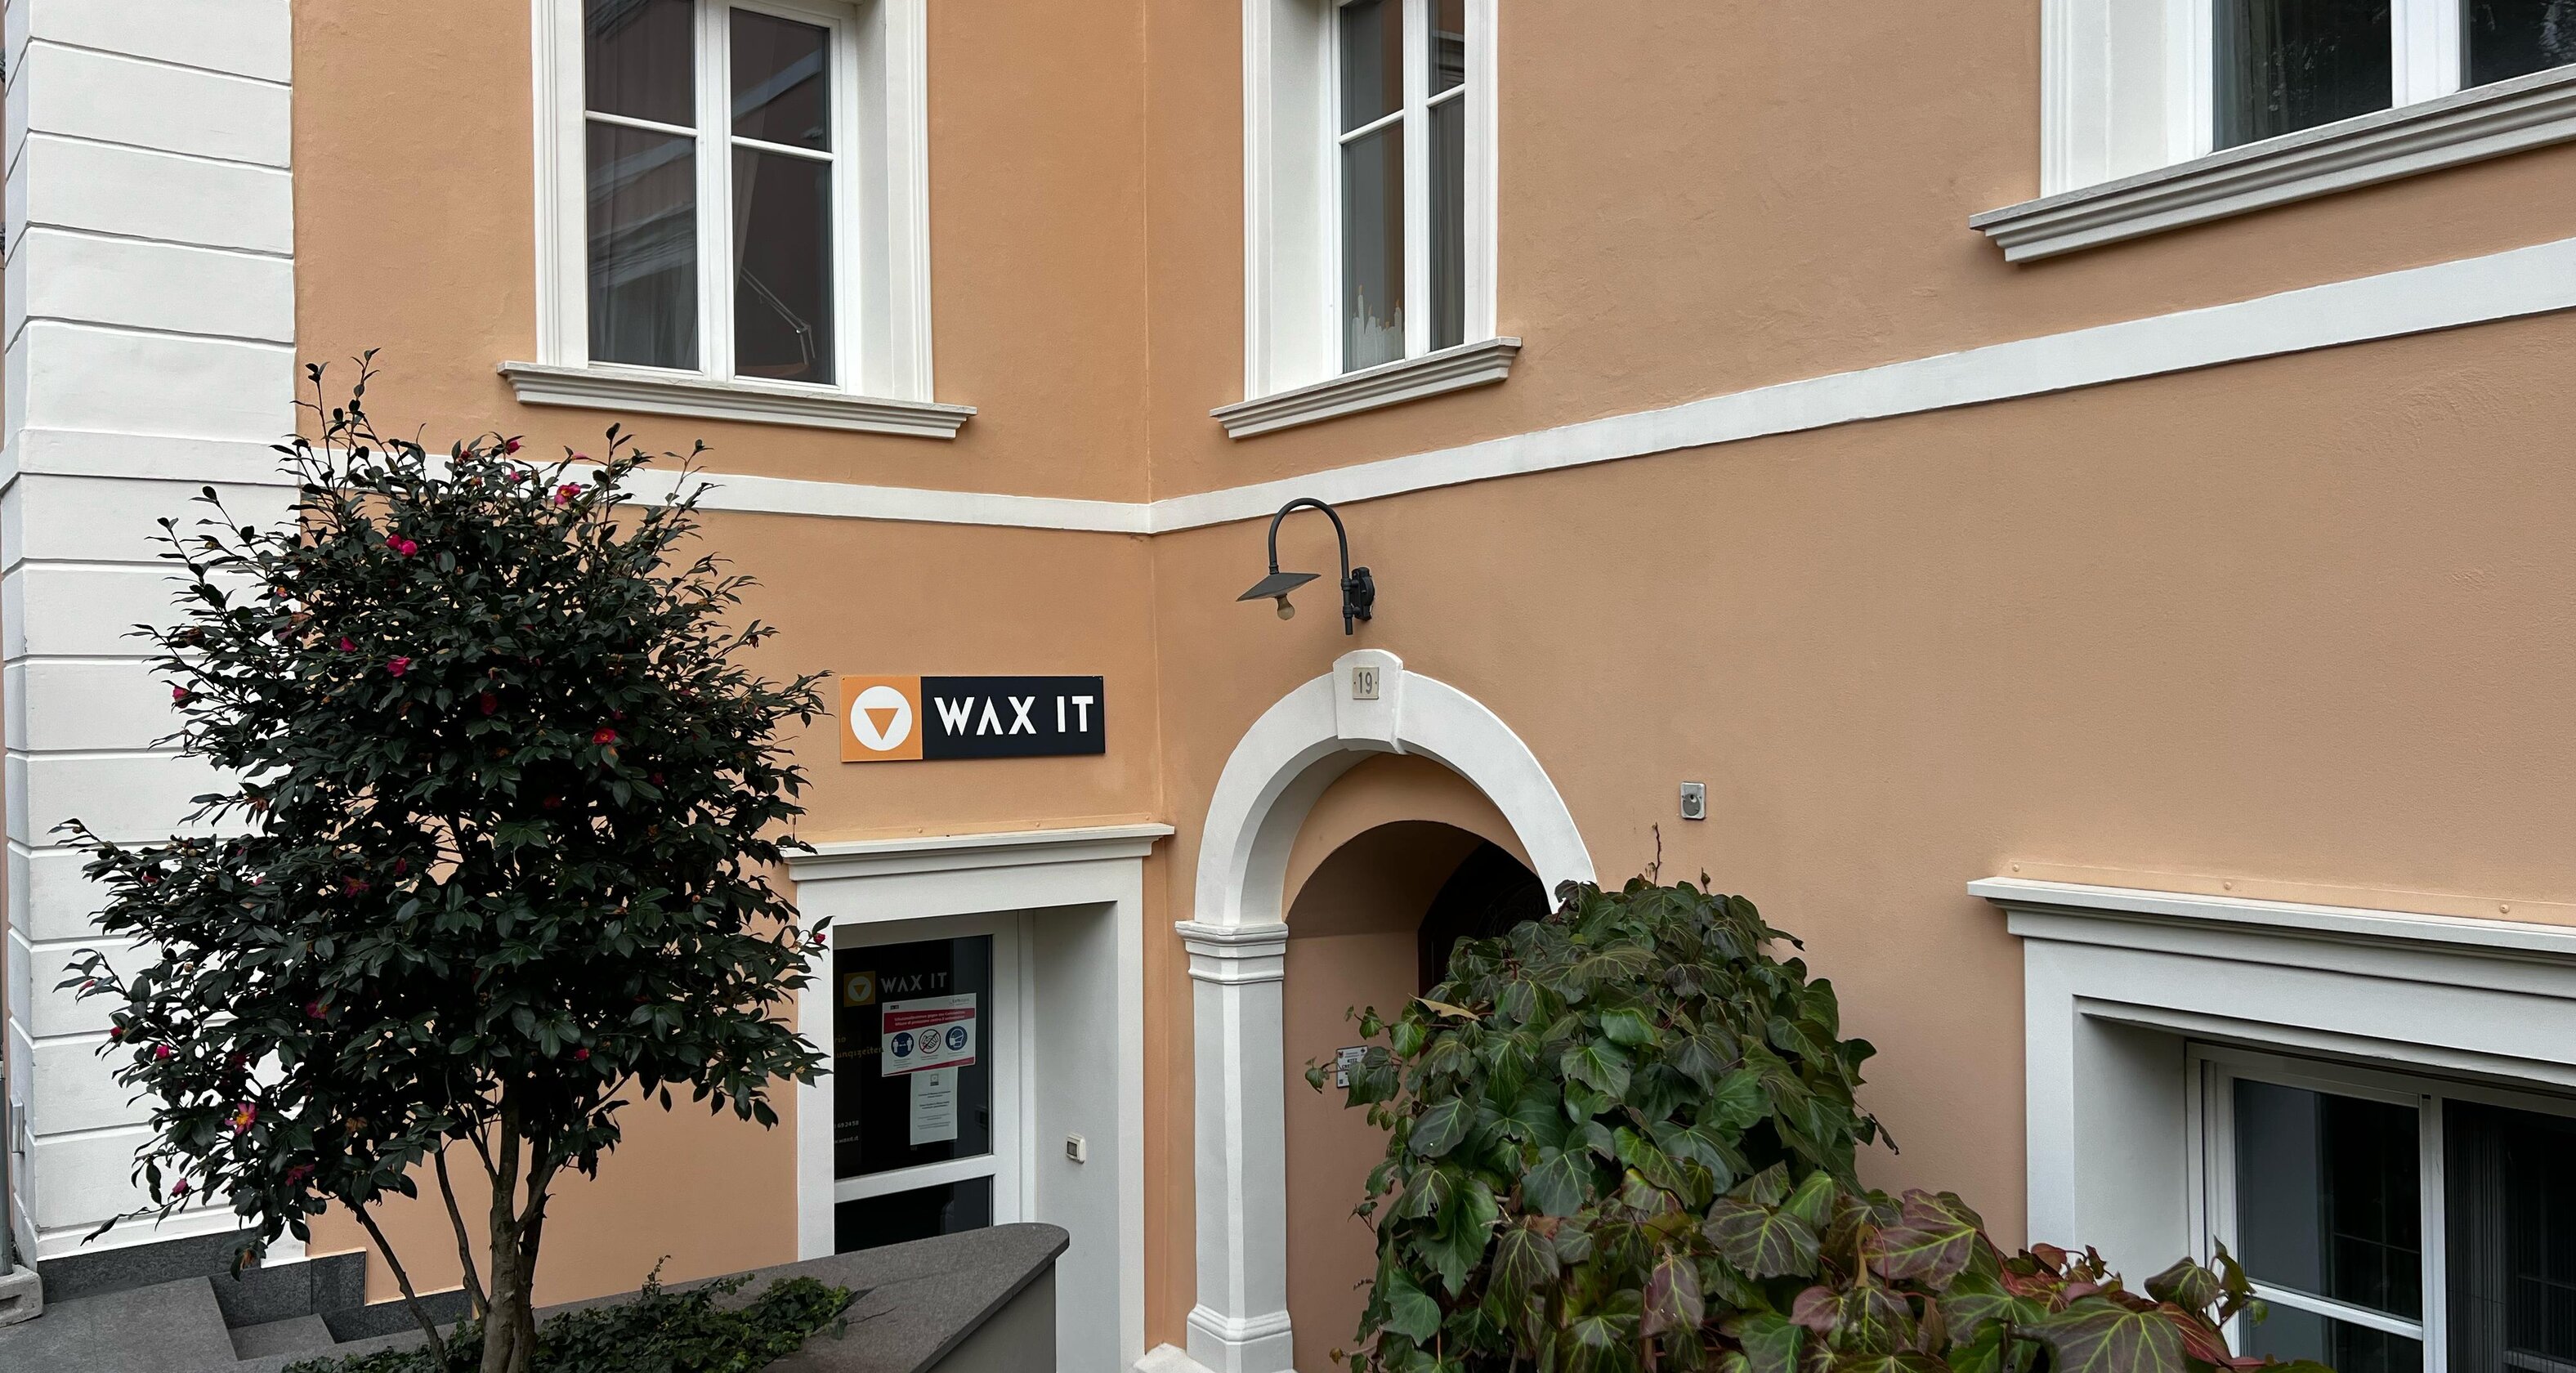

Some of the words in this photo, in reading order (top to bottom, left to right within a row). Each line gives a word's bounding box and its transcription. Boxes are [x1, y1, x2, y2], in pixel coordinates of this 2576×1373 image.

[1358, 671, 1373, 695] 19
[933, 695, 1037, 736] WAX
[1056, 695, 1094, 733] IT
[880, 974, 923, 994] WAX
[930, 972, 948, 989] IT
